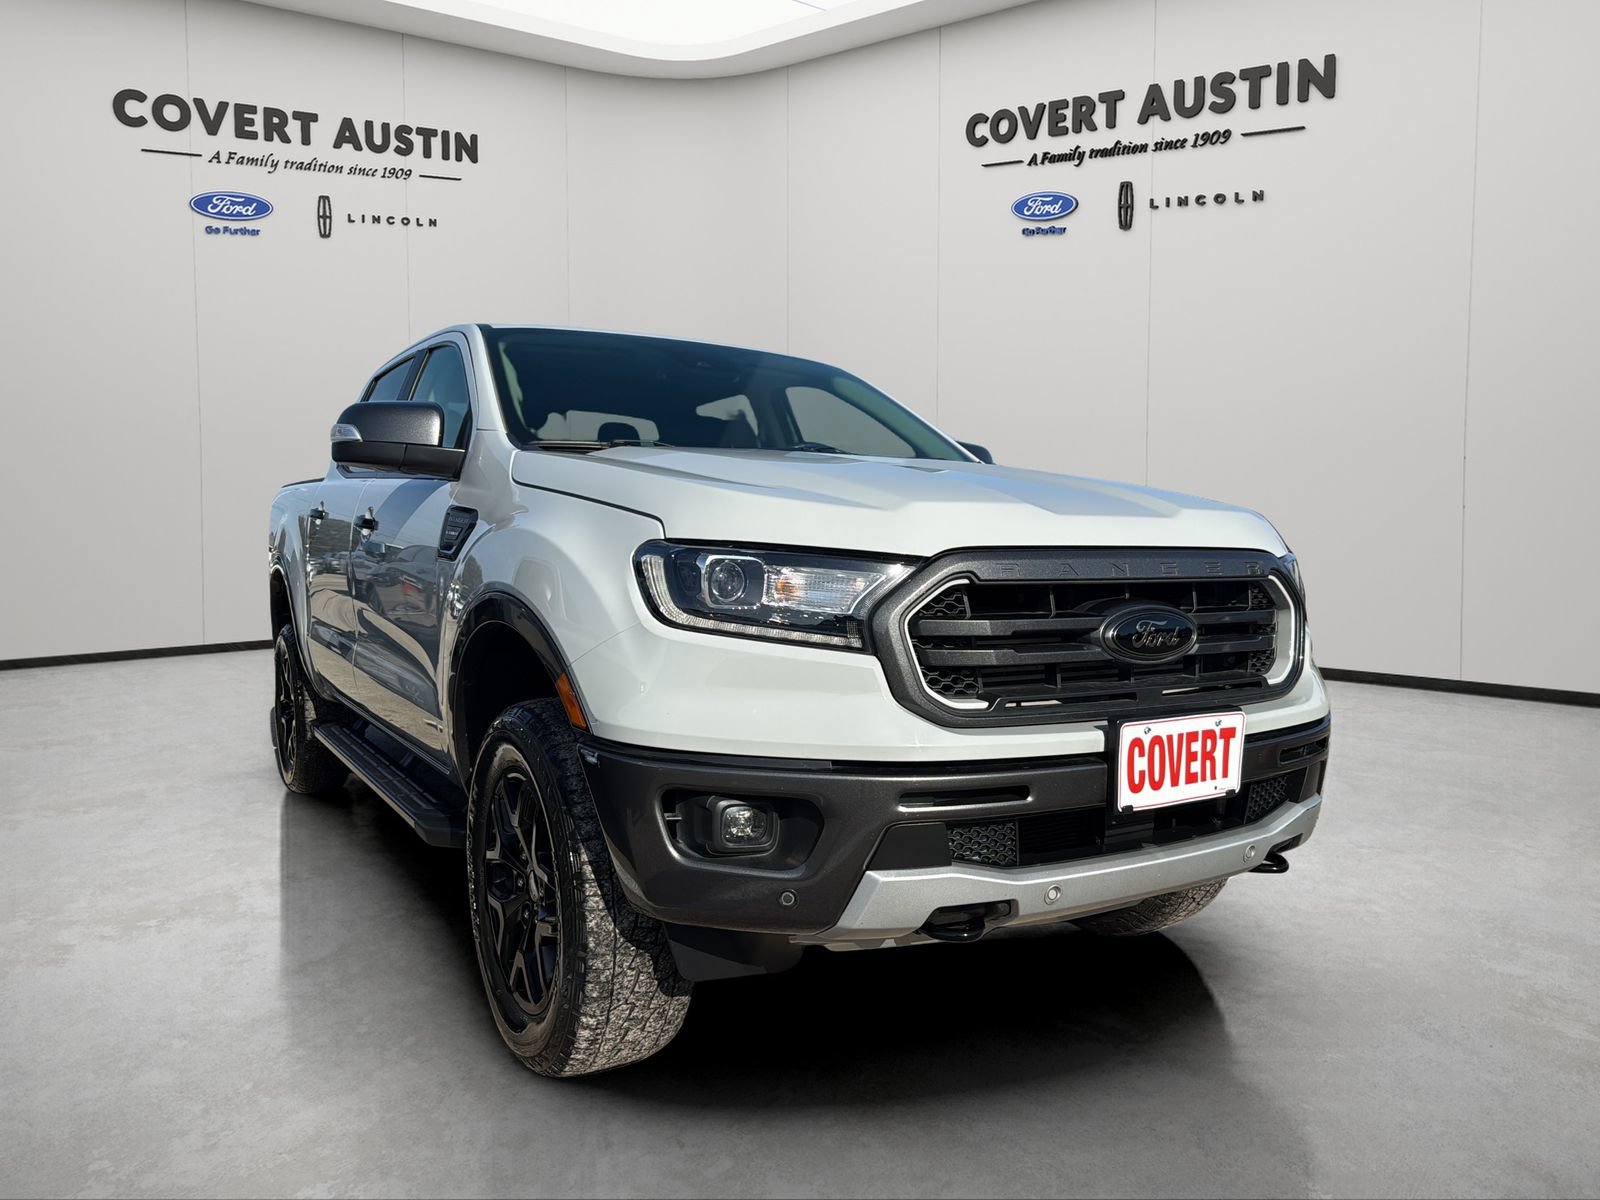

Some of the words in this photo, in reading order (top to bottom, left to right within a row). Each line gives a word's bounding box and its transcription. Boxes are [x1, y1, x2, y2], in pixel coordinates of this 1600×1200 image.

[965, 88, 1125, 148] COVERT
[1137, 53, 1337, 125] AUSTIN
[112, 88, 319, 146] COVERT
[332, 117, 479, 164] AUSTIN
[1026, 153, 1039, 167] A
[1039, 145, 1086, 168] Family
[1088, 140, 1149, 160] tradition
[1151, 137, 1188, 152] since
[1190, 128, 1232, 149] 1909
[208, 150, 222, 164] A
[225, 151, 280, 174] Family
[283, 157, 344, 175] tradition
[347, 165, 378, 178] since
[380, 166, 413, 180] 1909
[207, 195, 257, 216] Ford
[1023, 196, 1063, 216] Ford
[1149, 189, 1265, 210] LINCOLN
[205, 225, 221, 235] Go
[222, 226, 261, 236] Further
[347, 213, 438, 227] LINCOLN
[997, 561, 1265, 577] RANGER
[1132, 620, 1180, 649] Ford
[1127, 727, 1237, 794] COVERT
